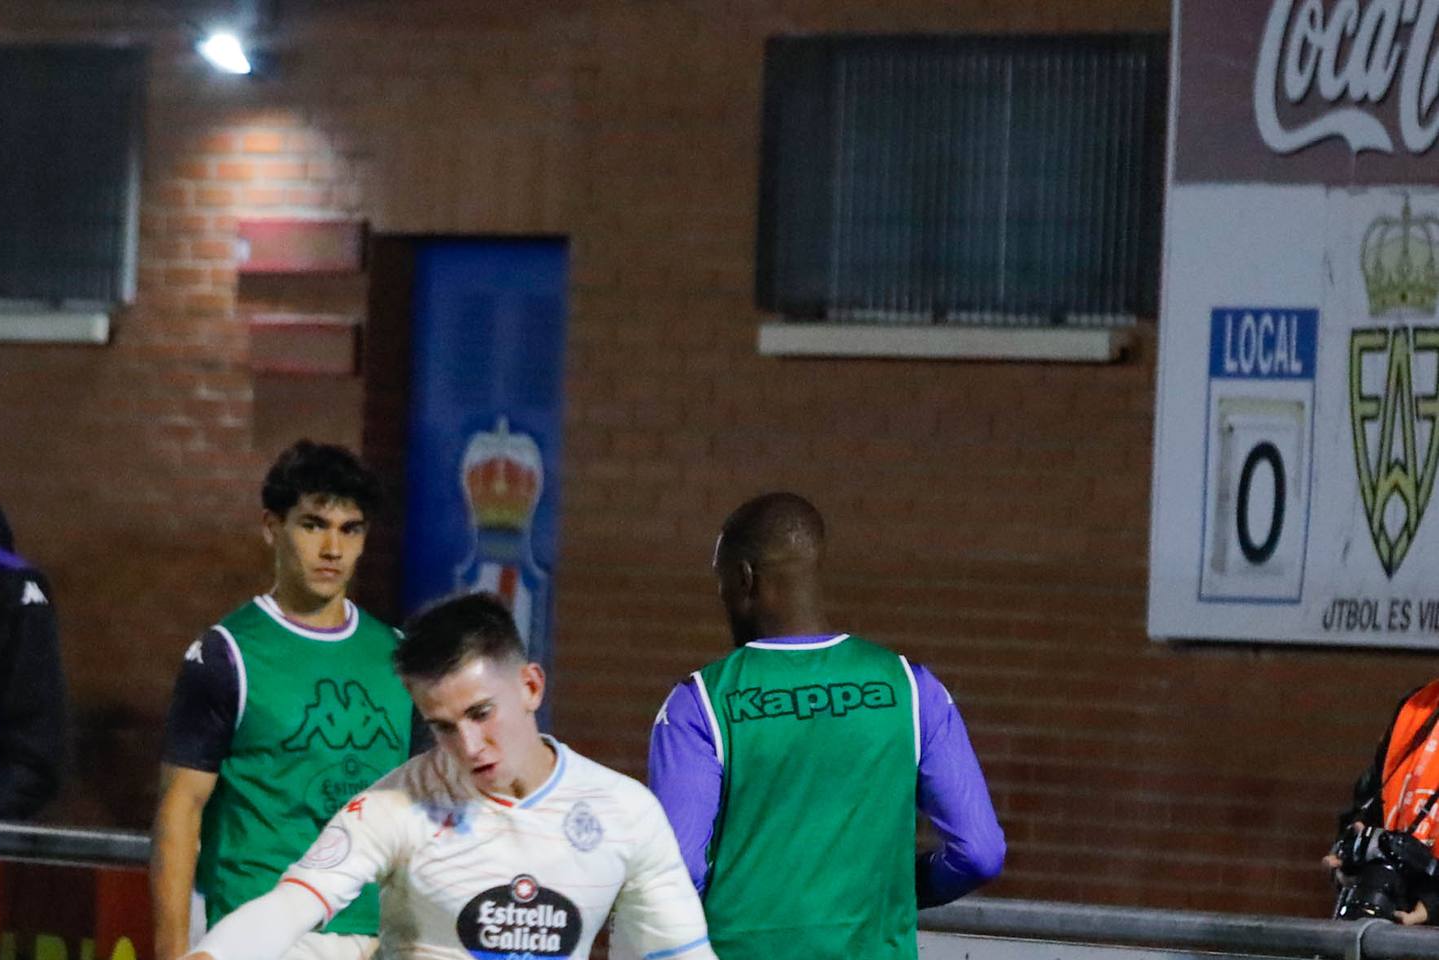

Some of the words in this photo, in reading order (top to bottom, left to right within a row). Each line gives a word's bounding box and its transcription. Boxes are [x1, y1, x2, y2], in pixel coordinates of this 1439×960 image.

[1224, 312, 1304, 375] LOCAL
[1236, 439, 1287, 567] 0
[1387, 597, 1413, 633] ES
[727, 682, 898, 724] Kappa
[476, 900, 568, 929] Estrella
[478, 924, 562, 952] Galicia
